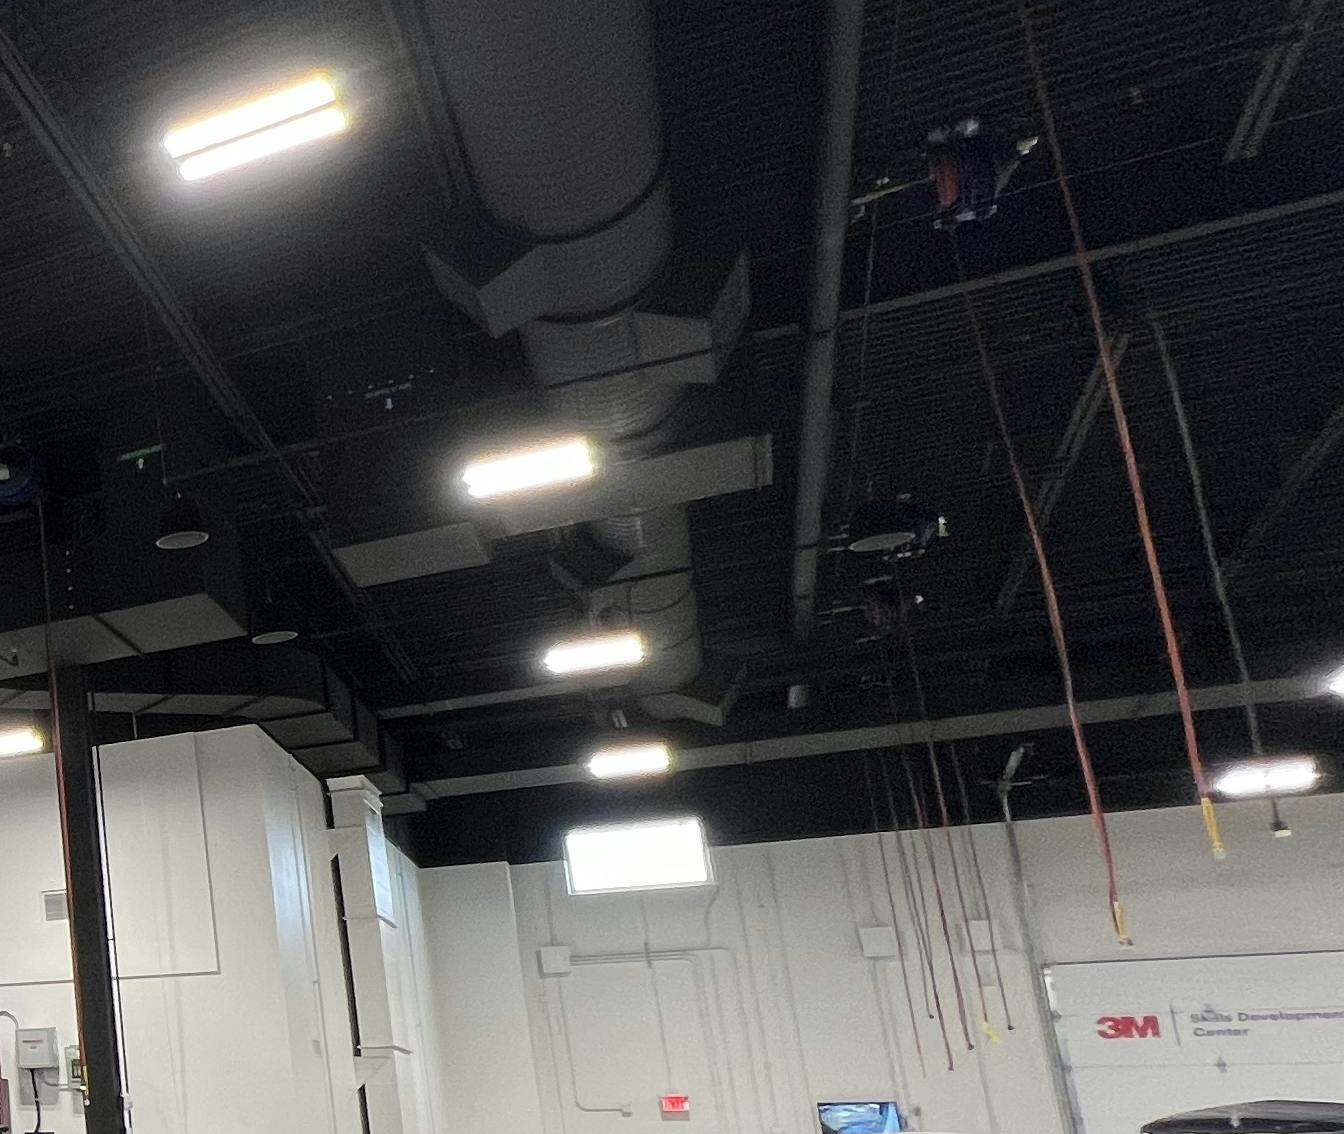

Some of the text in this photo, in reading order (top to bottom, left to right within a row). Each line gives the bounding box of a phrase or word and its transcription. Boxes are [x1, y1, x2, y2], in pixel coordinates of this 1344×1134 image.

[1238, 1010, 1344, 1022] Developmen
[1097, 1016, 1160, 1039] 3M
[1193, 1027, 1249, 1037] Center
